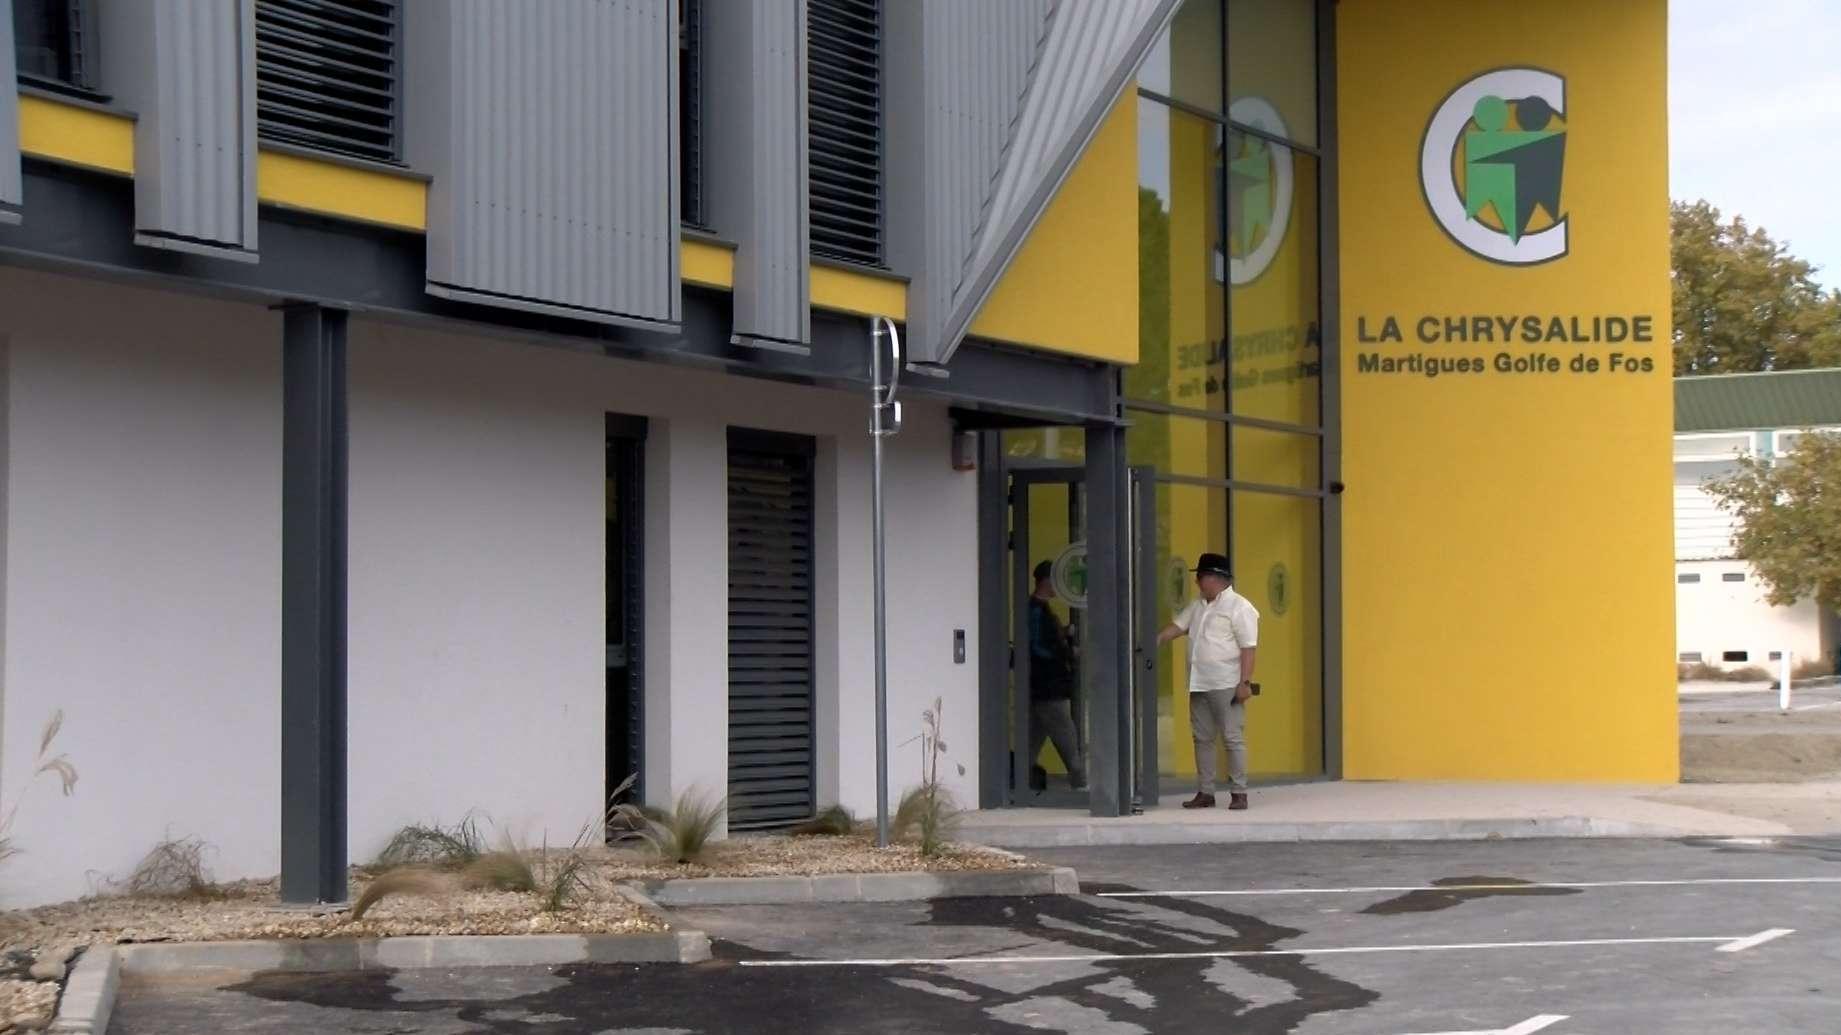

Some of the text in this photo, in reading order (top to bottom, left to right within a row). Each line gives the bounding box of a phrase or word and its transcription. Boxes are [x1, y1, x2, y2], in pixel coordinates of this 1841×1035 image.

[1357, 314, 1654, 345] LA CHRYSALIDE
[1357, 351, 1655, 379] Martigues Golfe de Fos
